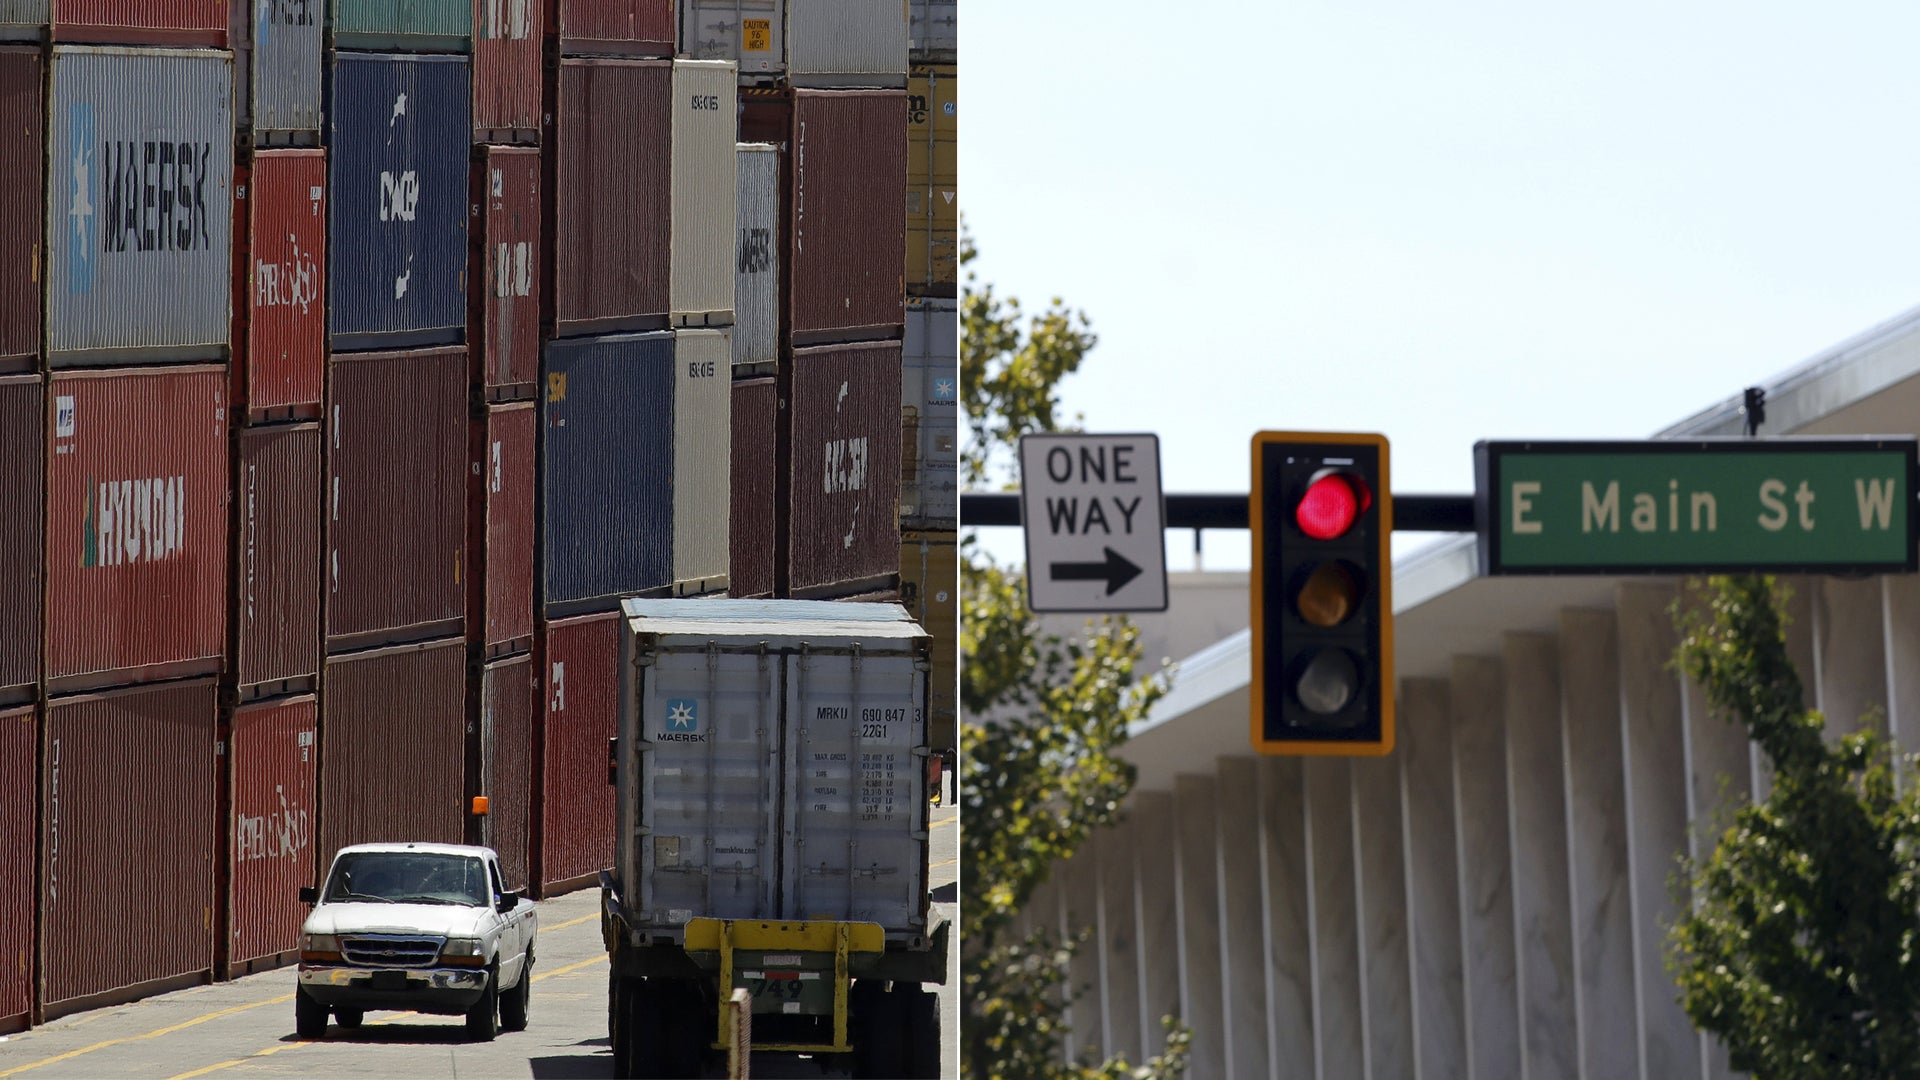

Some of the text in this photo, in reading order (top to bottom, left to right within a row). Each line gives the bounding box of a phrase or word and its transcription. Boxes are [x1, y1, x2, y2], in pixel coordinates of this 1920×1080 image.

[104, 140, 210, 253] MAERSK
[1046, 446, 1137, 484] ONE
[99, 475, 184, 568] HYUNDAI
[1046, 497, 1142, 535] WAY
[1511, 478, 1896, 534] E Main St W
[862, 708, 882, 721] 690
[885, 708, 905, 721] 847
[915, 708, 921, 722] 3
[863, 724, 888, 738] 22G1
[658, 733, 705, 743] MAERSK
[753, 980, 804, 998] 749
